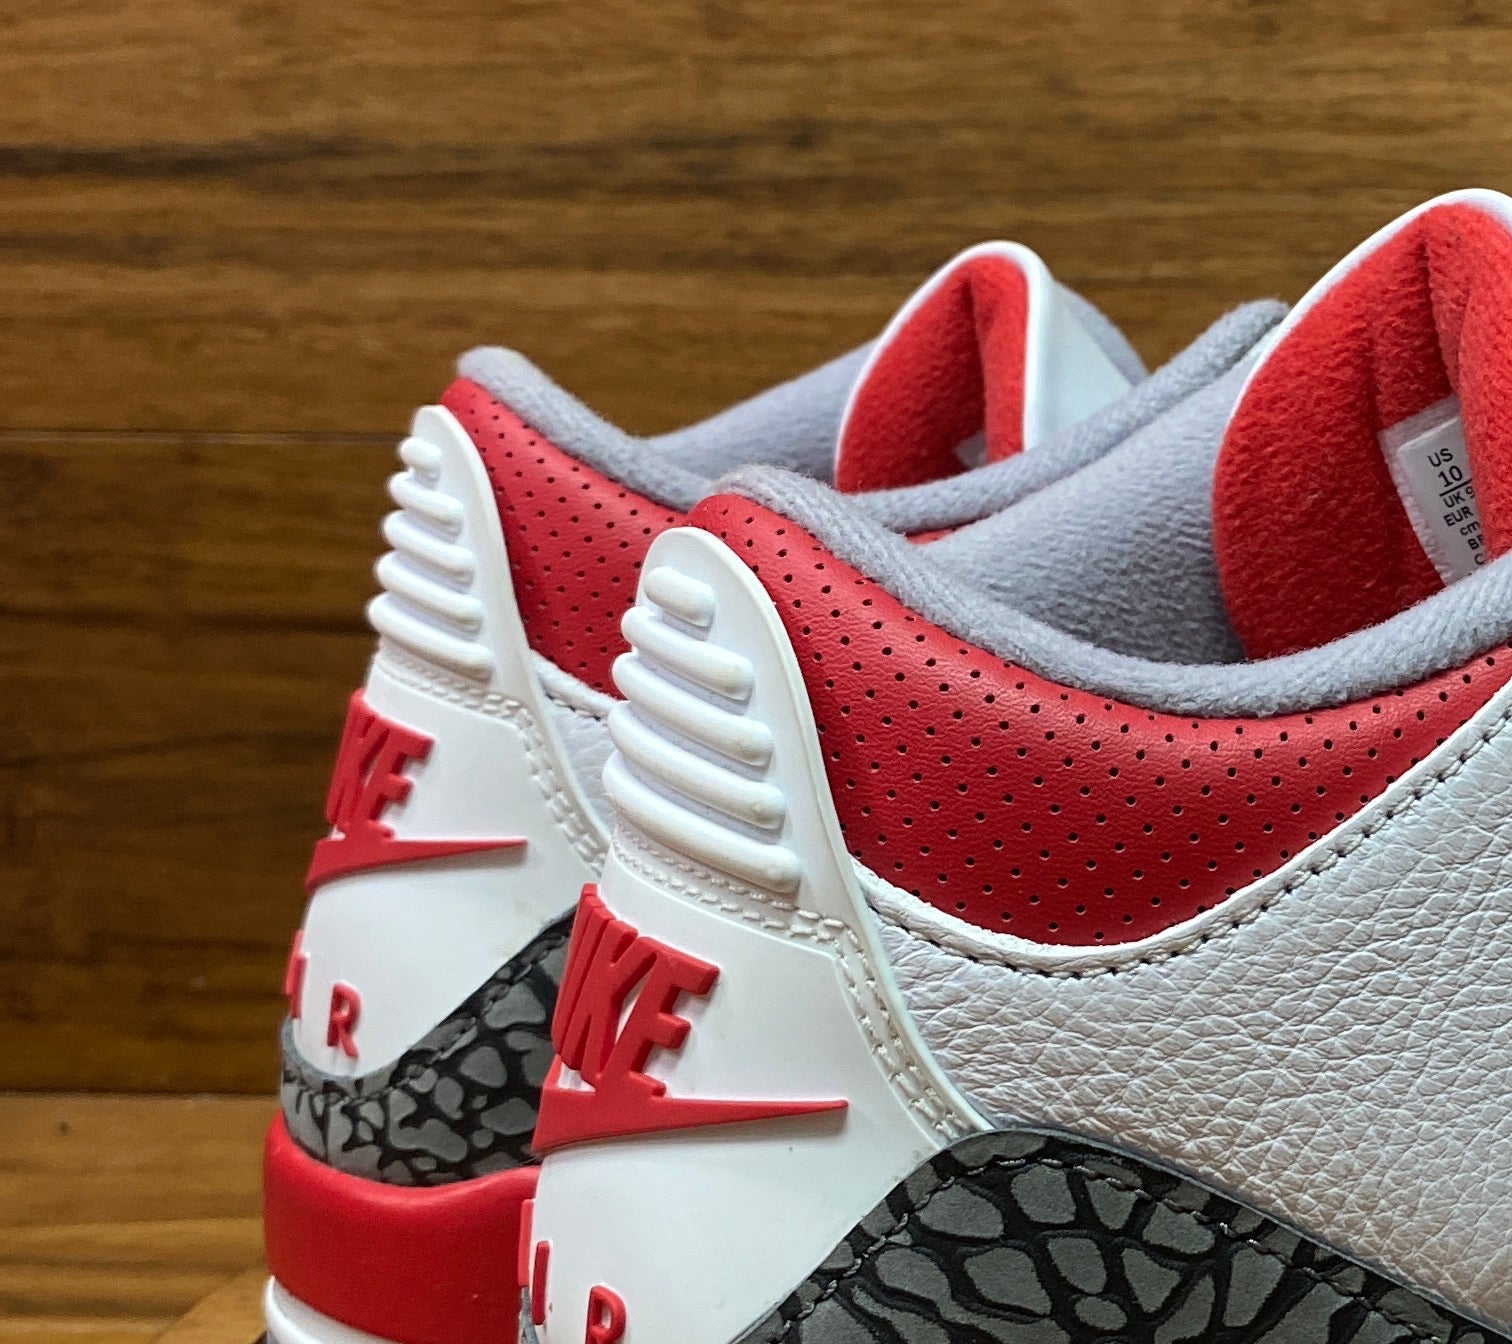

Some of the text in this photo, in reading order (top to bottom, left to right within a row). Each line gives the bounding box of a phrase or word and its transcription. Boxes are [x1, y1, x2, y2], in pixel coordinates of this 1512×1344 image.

[1428, 448, 1454, 467] US
[1438, 465, 1463, 488] 10
[1443, 491, 1466, 508] UK
[1443, 506, 1474, 527] EUR
